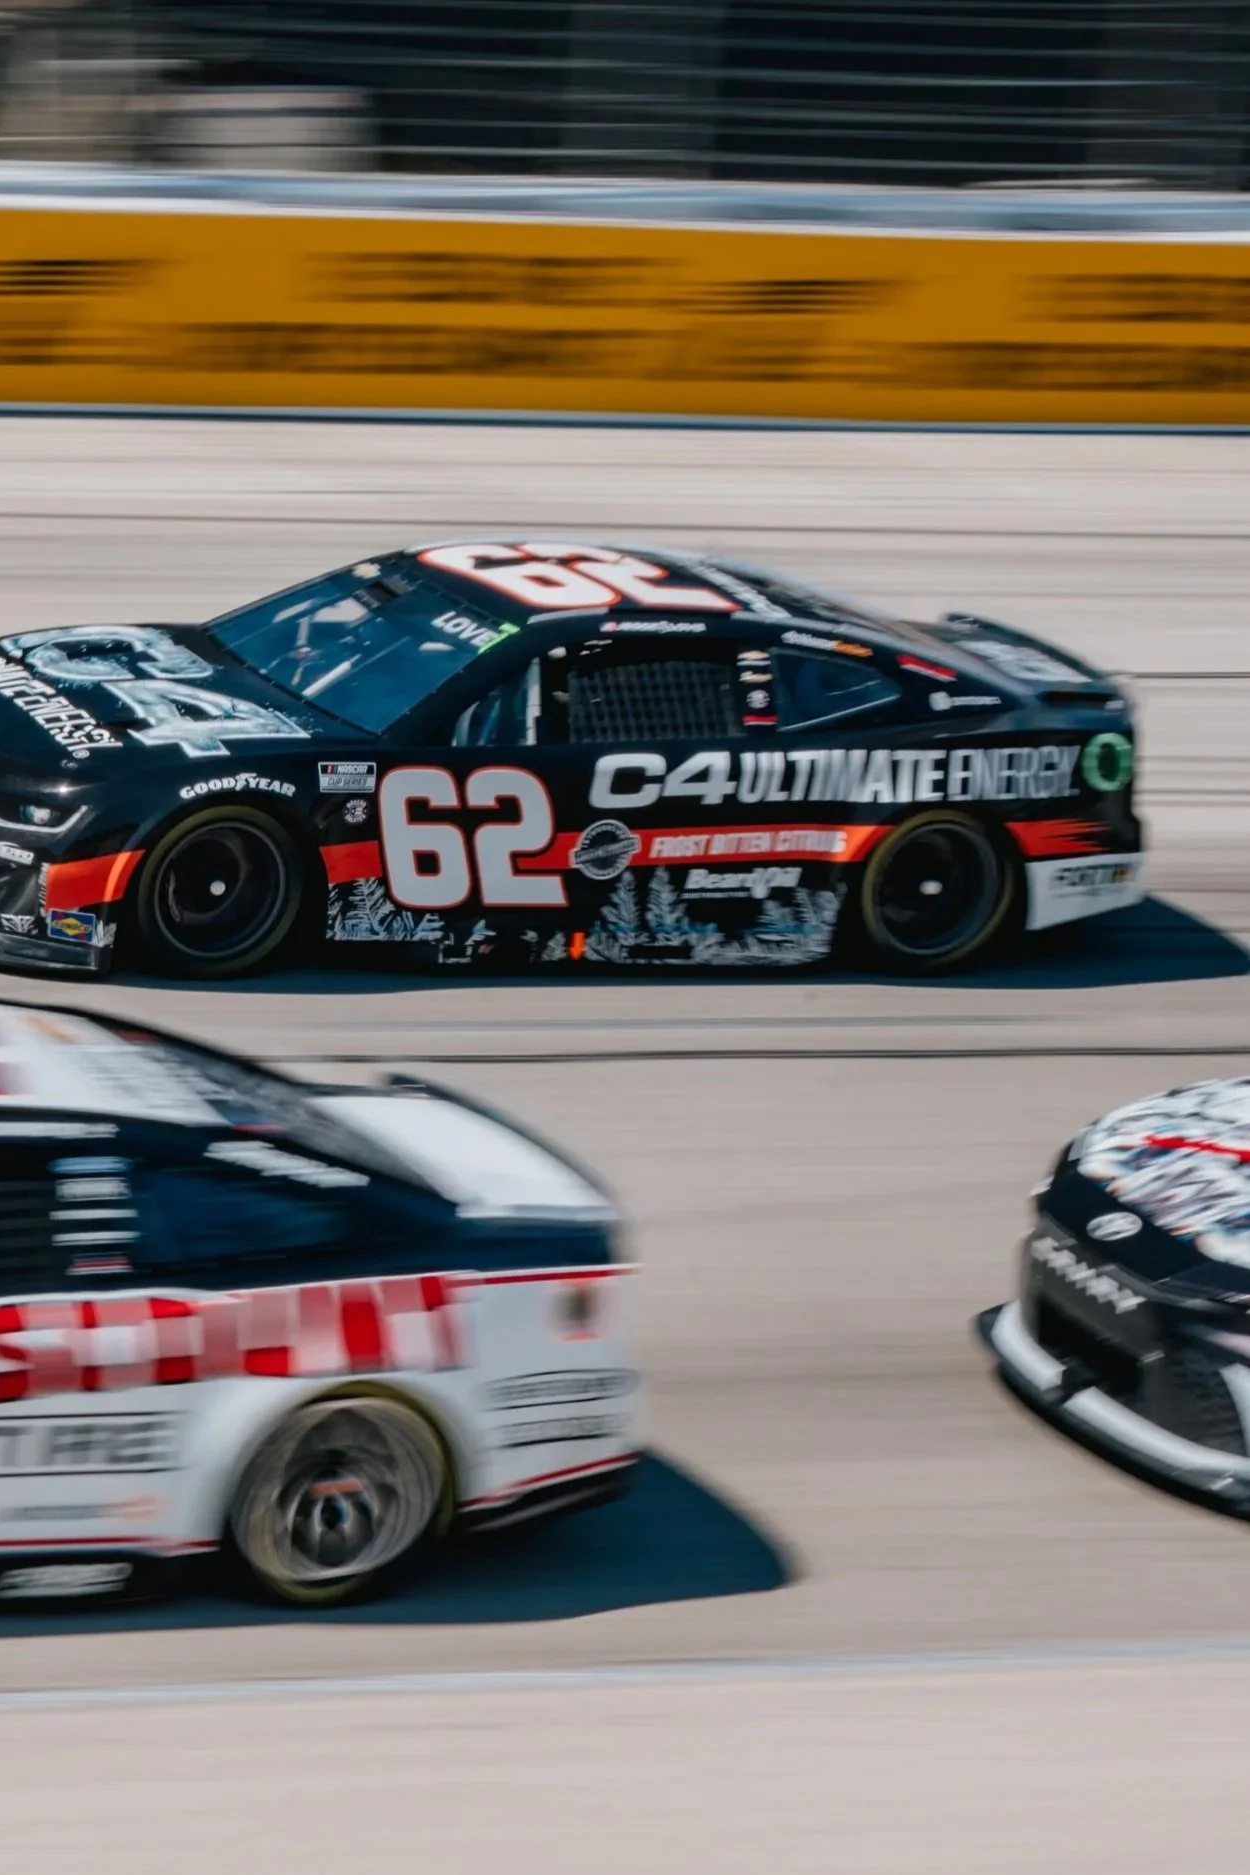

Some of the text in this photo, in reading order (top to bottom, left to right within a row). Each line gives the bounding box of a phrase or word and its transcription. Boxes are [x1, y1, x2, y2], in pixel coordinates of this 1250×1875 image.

[416, 541, 743, 613] 62
[430, 610, 500, 647] LOVE
[179, 772, 297, 800] GOODYEAR
[327, 777, 343, 786] CUP
[588, 750, 738, 809] C4
[737, 748, 947, 803] ULTIMATE
[379, 764, 570, 910] 62
